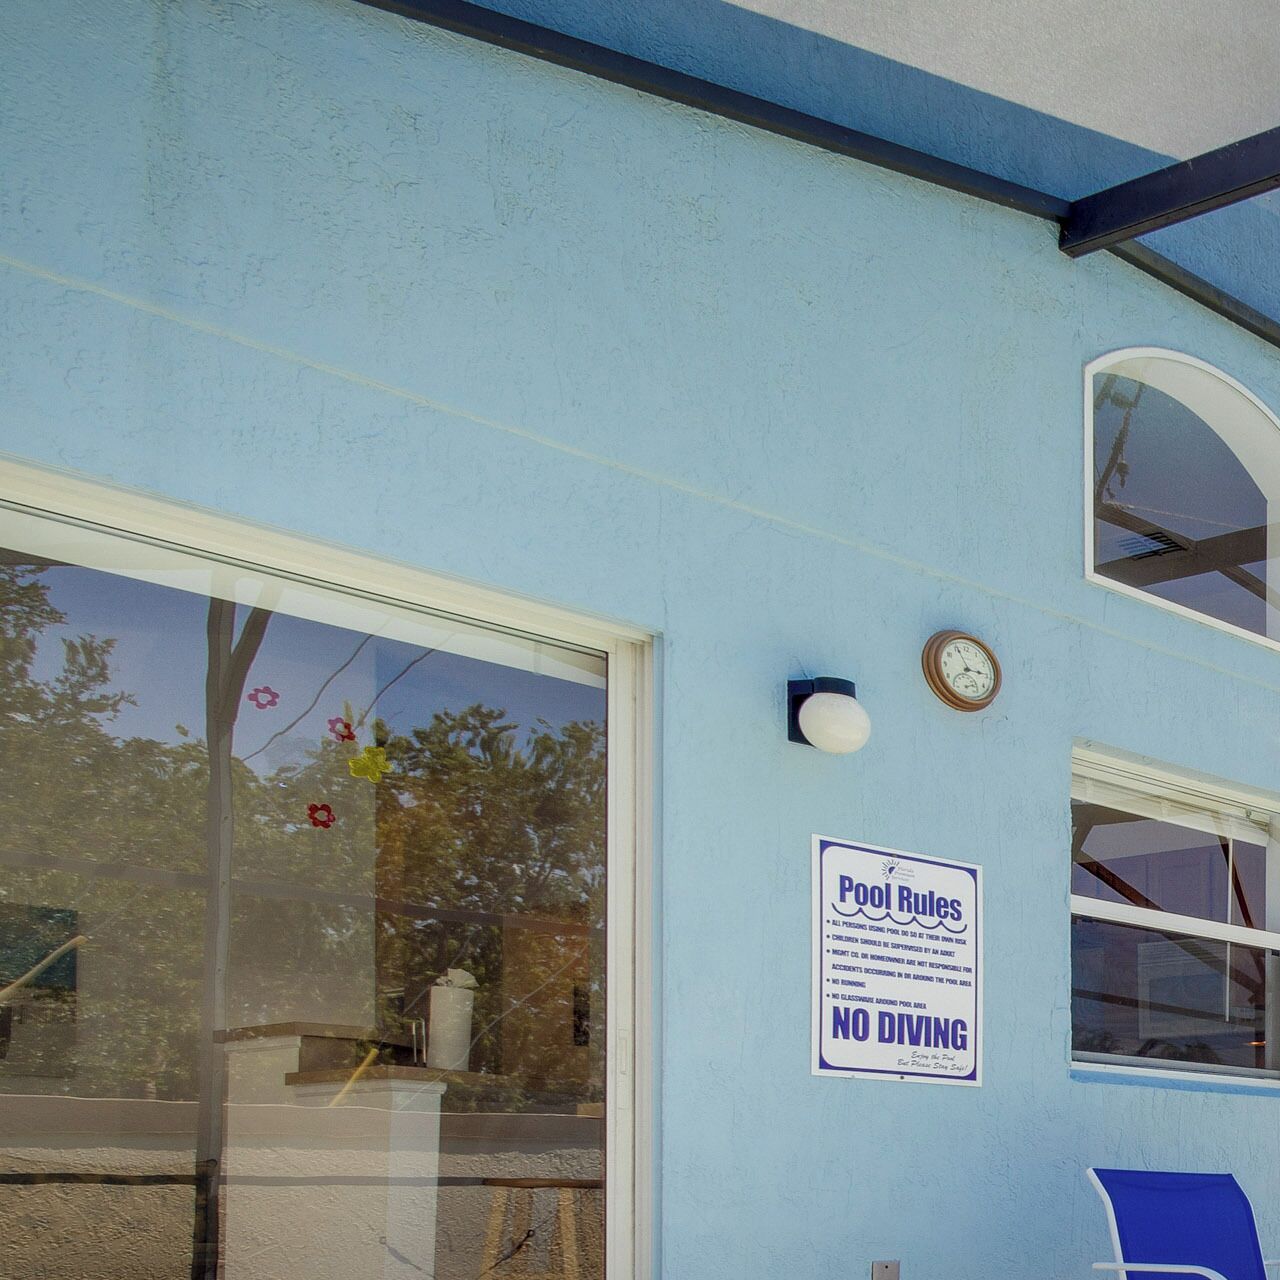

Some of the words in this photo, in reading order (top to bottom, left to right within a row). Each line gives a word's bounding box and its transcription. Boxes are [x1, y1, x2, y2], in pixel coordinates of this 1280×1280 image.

[839, 874, 891, 910] Pool
[898, 885, 963, 921] Rules
[842, 921, 868, 931] PERSONS
[869, 925, 886, 934] USING
[887, 927, 900, 936] POOL
[926, 934, 940, 942] THEIR
[941, 936, 954, 944] OWN
[955, 938, 967, 946] RISK
[832, 934, 859, 944] CHILDREN
[860, 938, 882, 947] SHOULD
[891, 942, 924, 953] SUPERVISED
[940, 949, 956, 958] ADULT
[861, 952, 869, 960] OR
[870, 953, 905, 965] HOMEOWNER
[906, 959, 916, 967] ARE
[917, 960, 928, 968] NOT
[929, 961, 962, 973] RESPONSIBLE
[963, 966, 973, 974] FOR
[832, 963, 863, 974] ACCIDENTS
[913, 973, 934, 982] AROUND
[935, 976, 945, 984] THE
[946, 978, 958, 986] POOL
[959, 979, 972, 987] AREA
[841, 979, 867, 989] RUNNING
[832, 992, 840, 1000] NO
[841, 993, 874, 1004] GLASSWARE
[876, 997, 898, 1007] AROUND
[899, 1000, 912, 1008] POOL
[913, 1001, 927, 1010] AREA
[832, 1005, 870, 1042] NO
[878, 1010, 968, 1051] DIVING
[911, 1050, 930, 1061] Enjoy
[931, 1053, 940, 1061] the
[911, 1059, 931, 1069] Please
[933, 1062, 948, 1071] Stay
